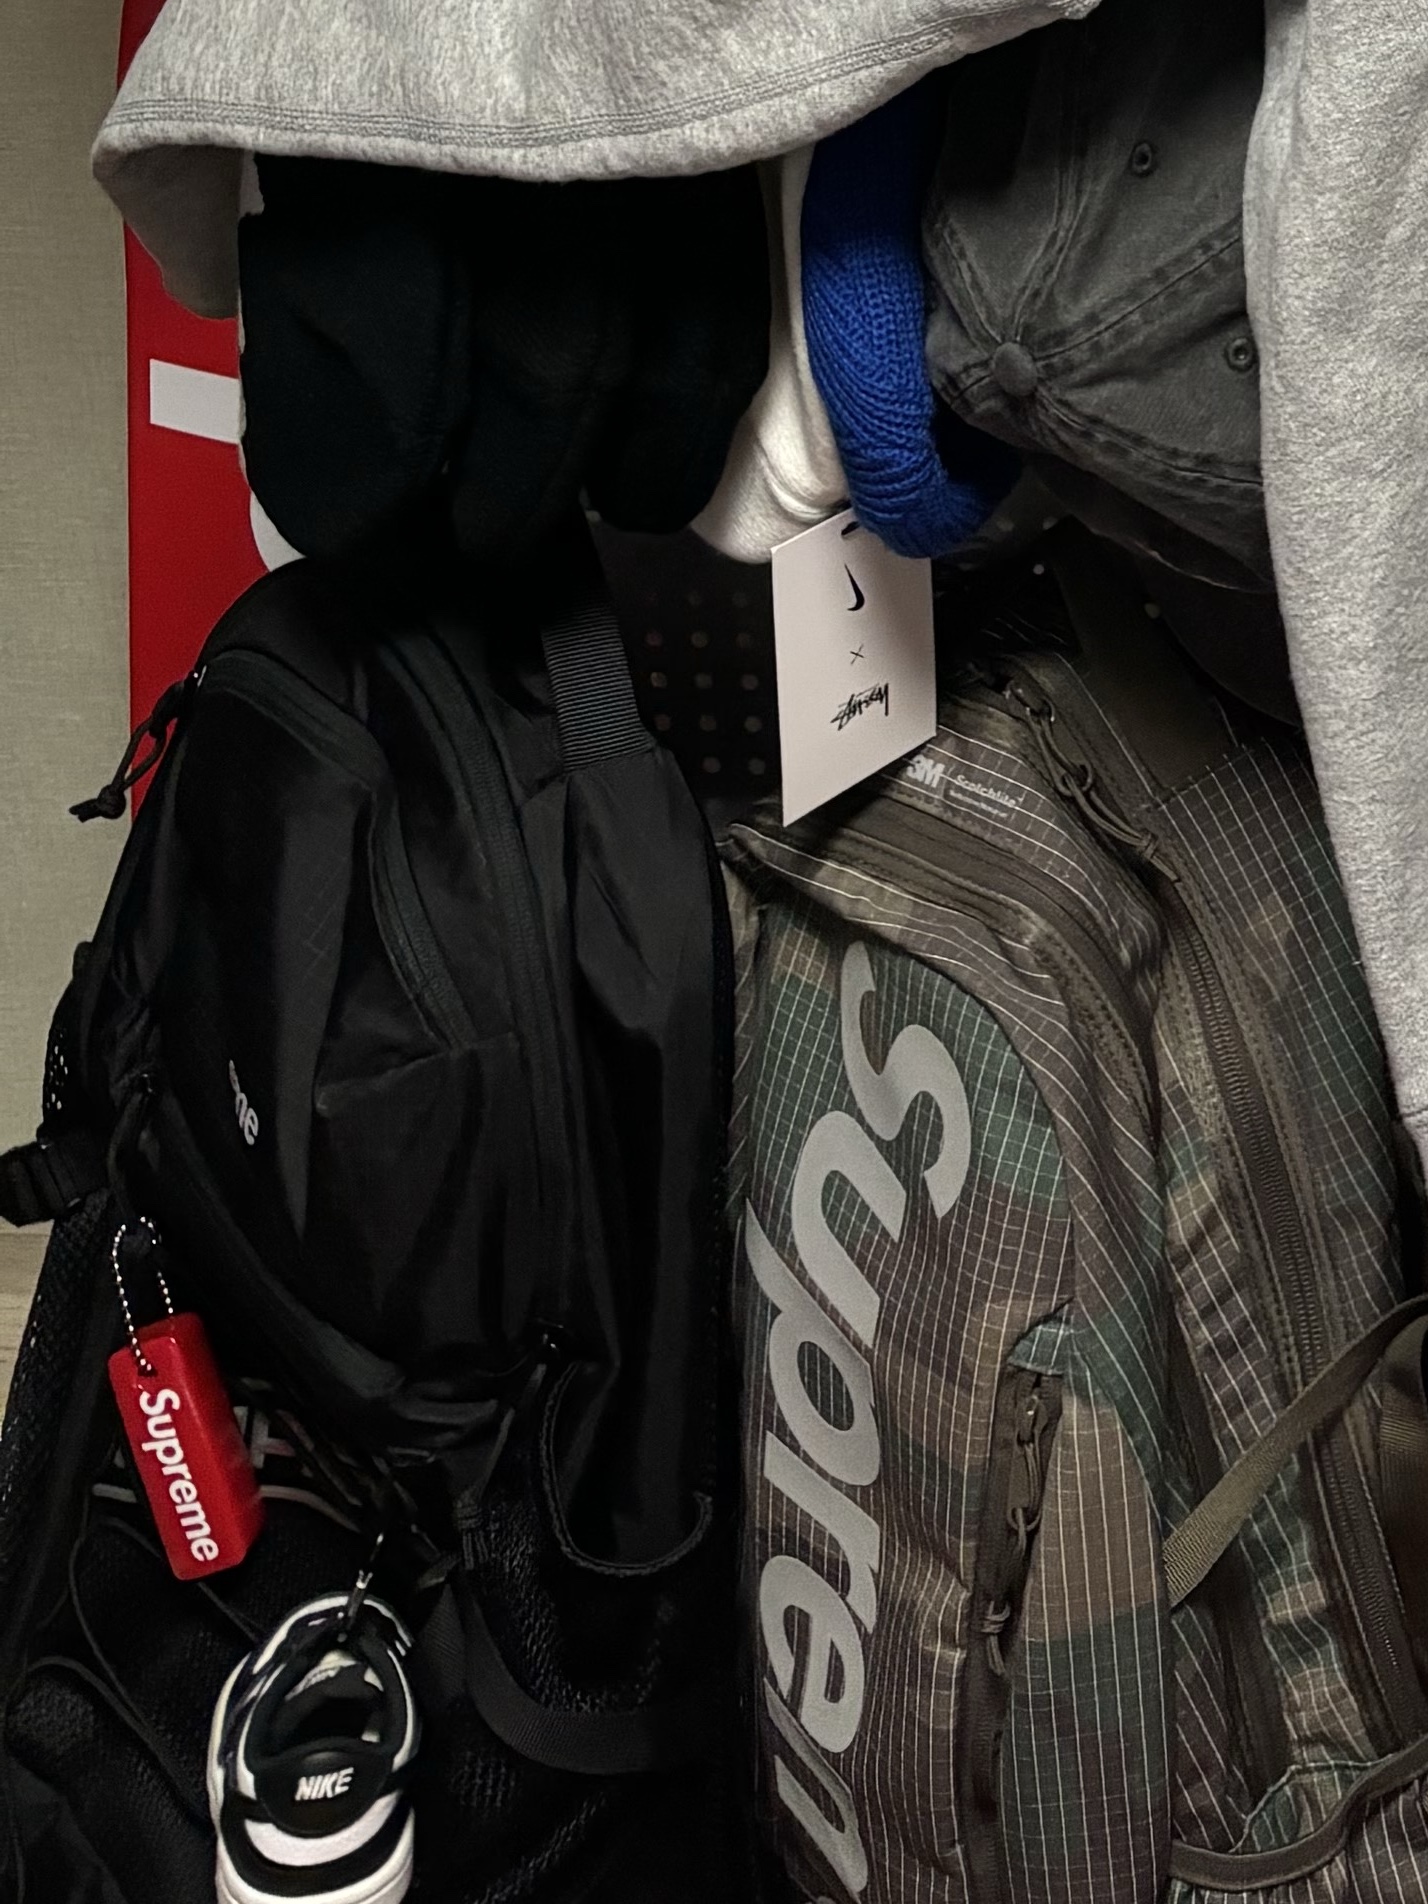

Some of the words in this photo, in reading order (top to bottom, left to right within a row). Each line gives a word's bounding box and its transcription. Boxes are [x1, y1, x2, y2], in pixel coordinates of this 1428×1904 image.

[906, 754, 946, 788] 3M
[140, 1389, 218, 1561] Supreme
[296, 1768, 353, 1800] NIKE
